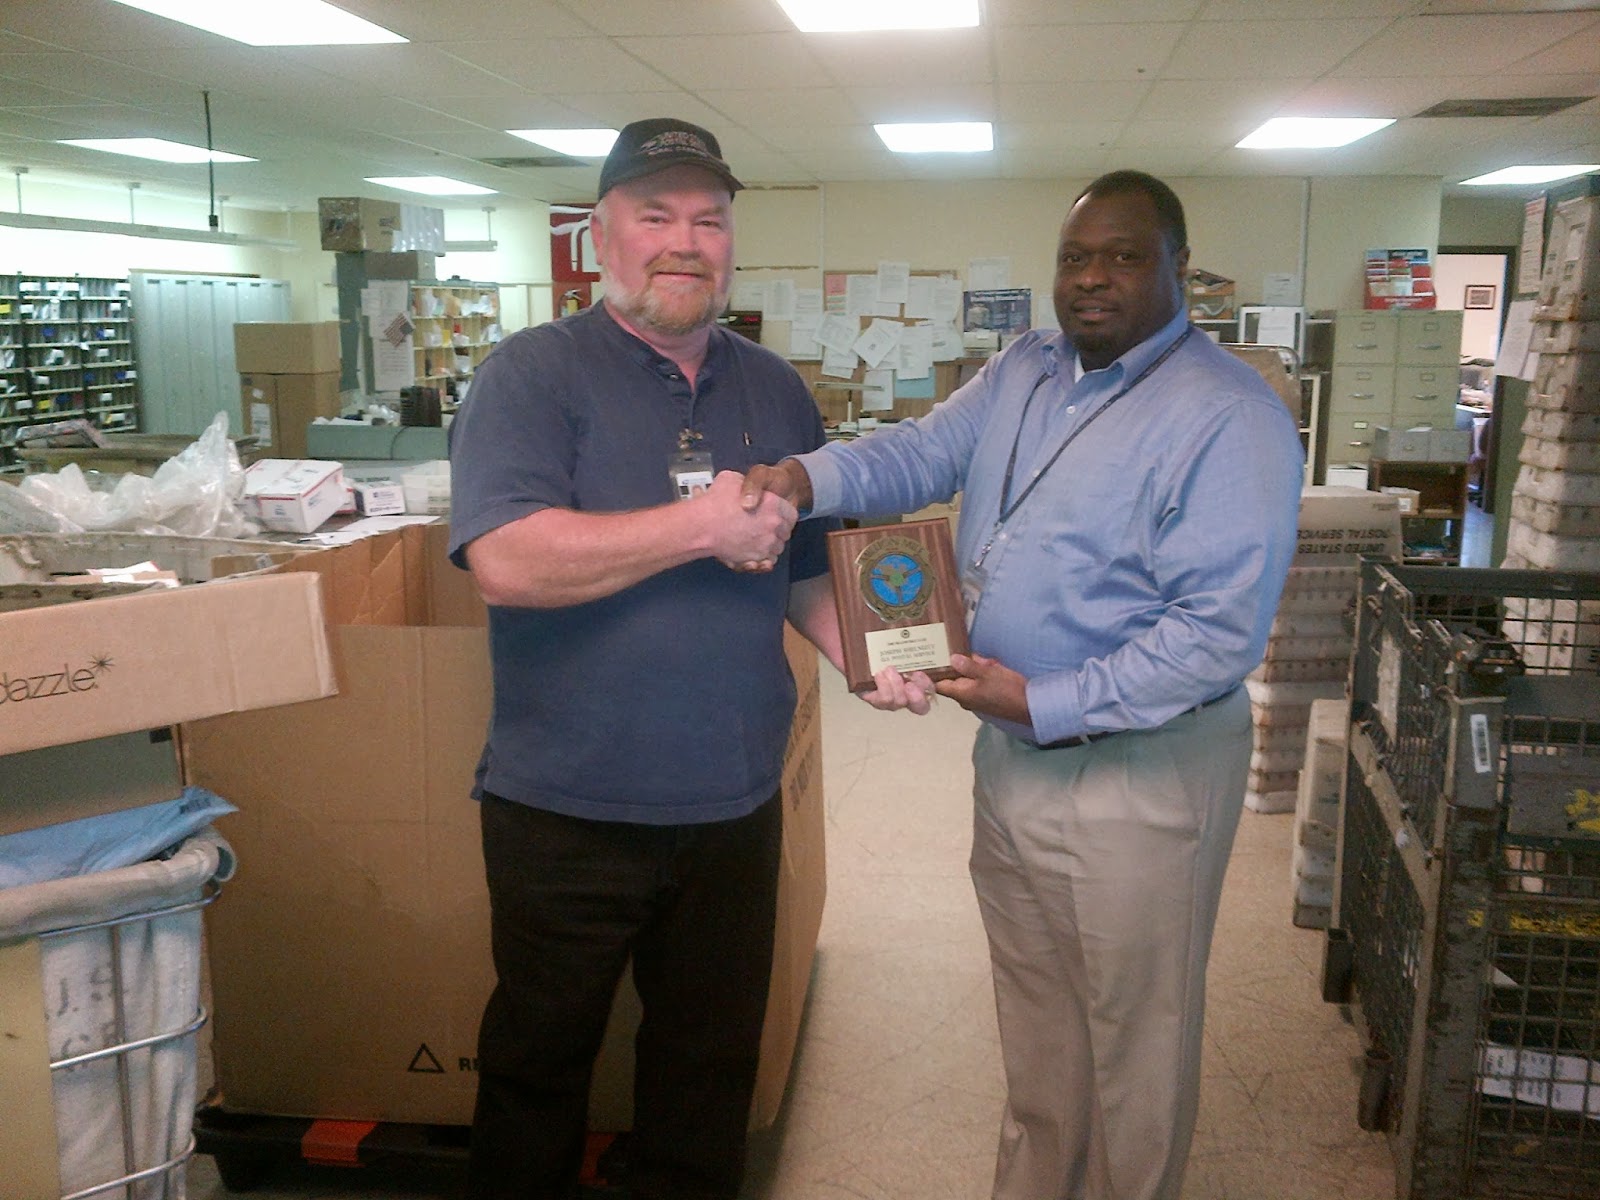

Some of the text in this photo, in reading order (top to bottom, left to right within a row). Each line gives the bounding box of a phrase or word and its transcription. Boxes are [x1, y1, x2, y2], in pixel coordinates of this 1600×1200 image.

[1296, 528, 1391, 539] POSTAL SERVICE
[1298, 543, 1385, 554] UNITED STATES
